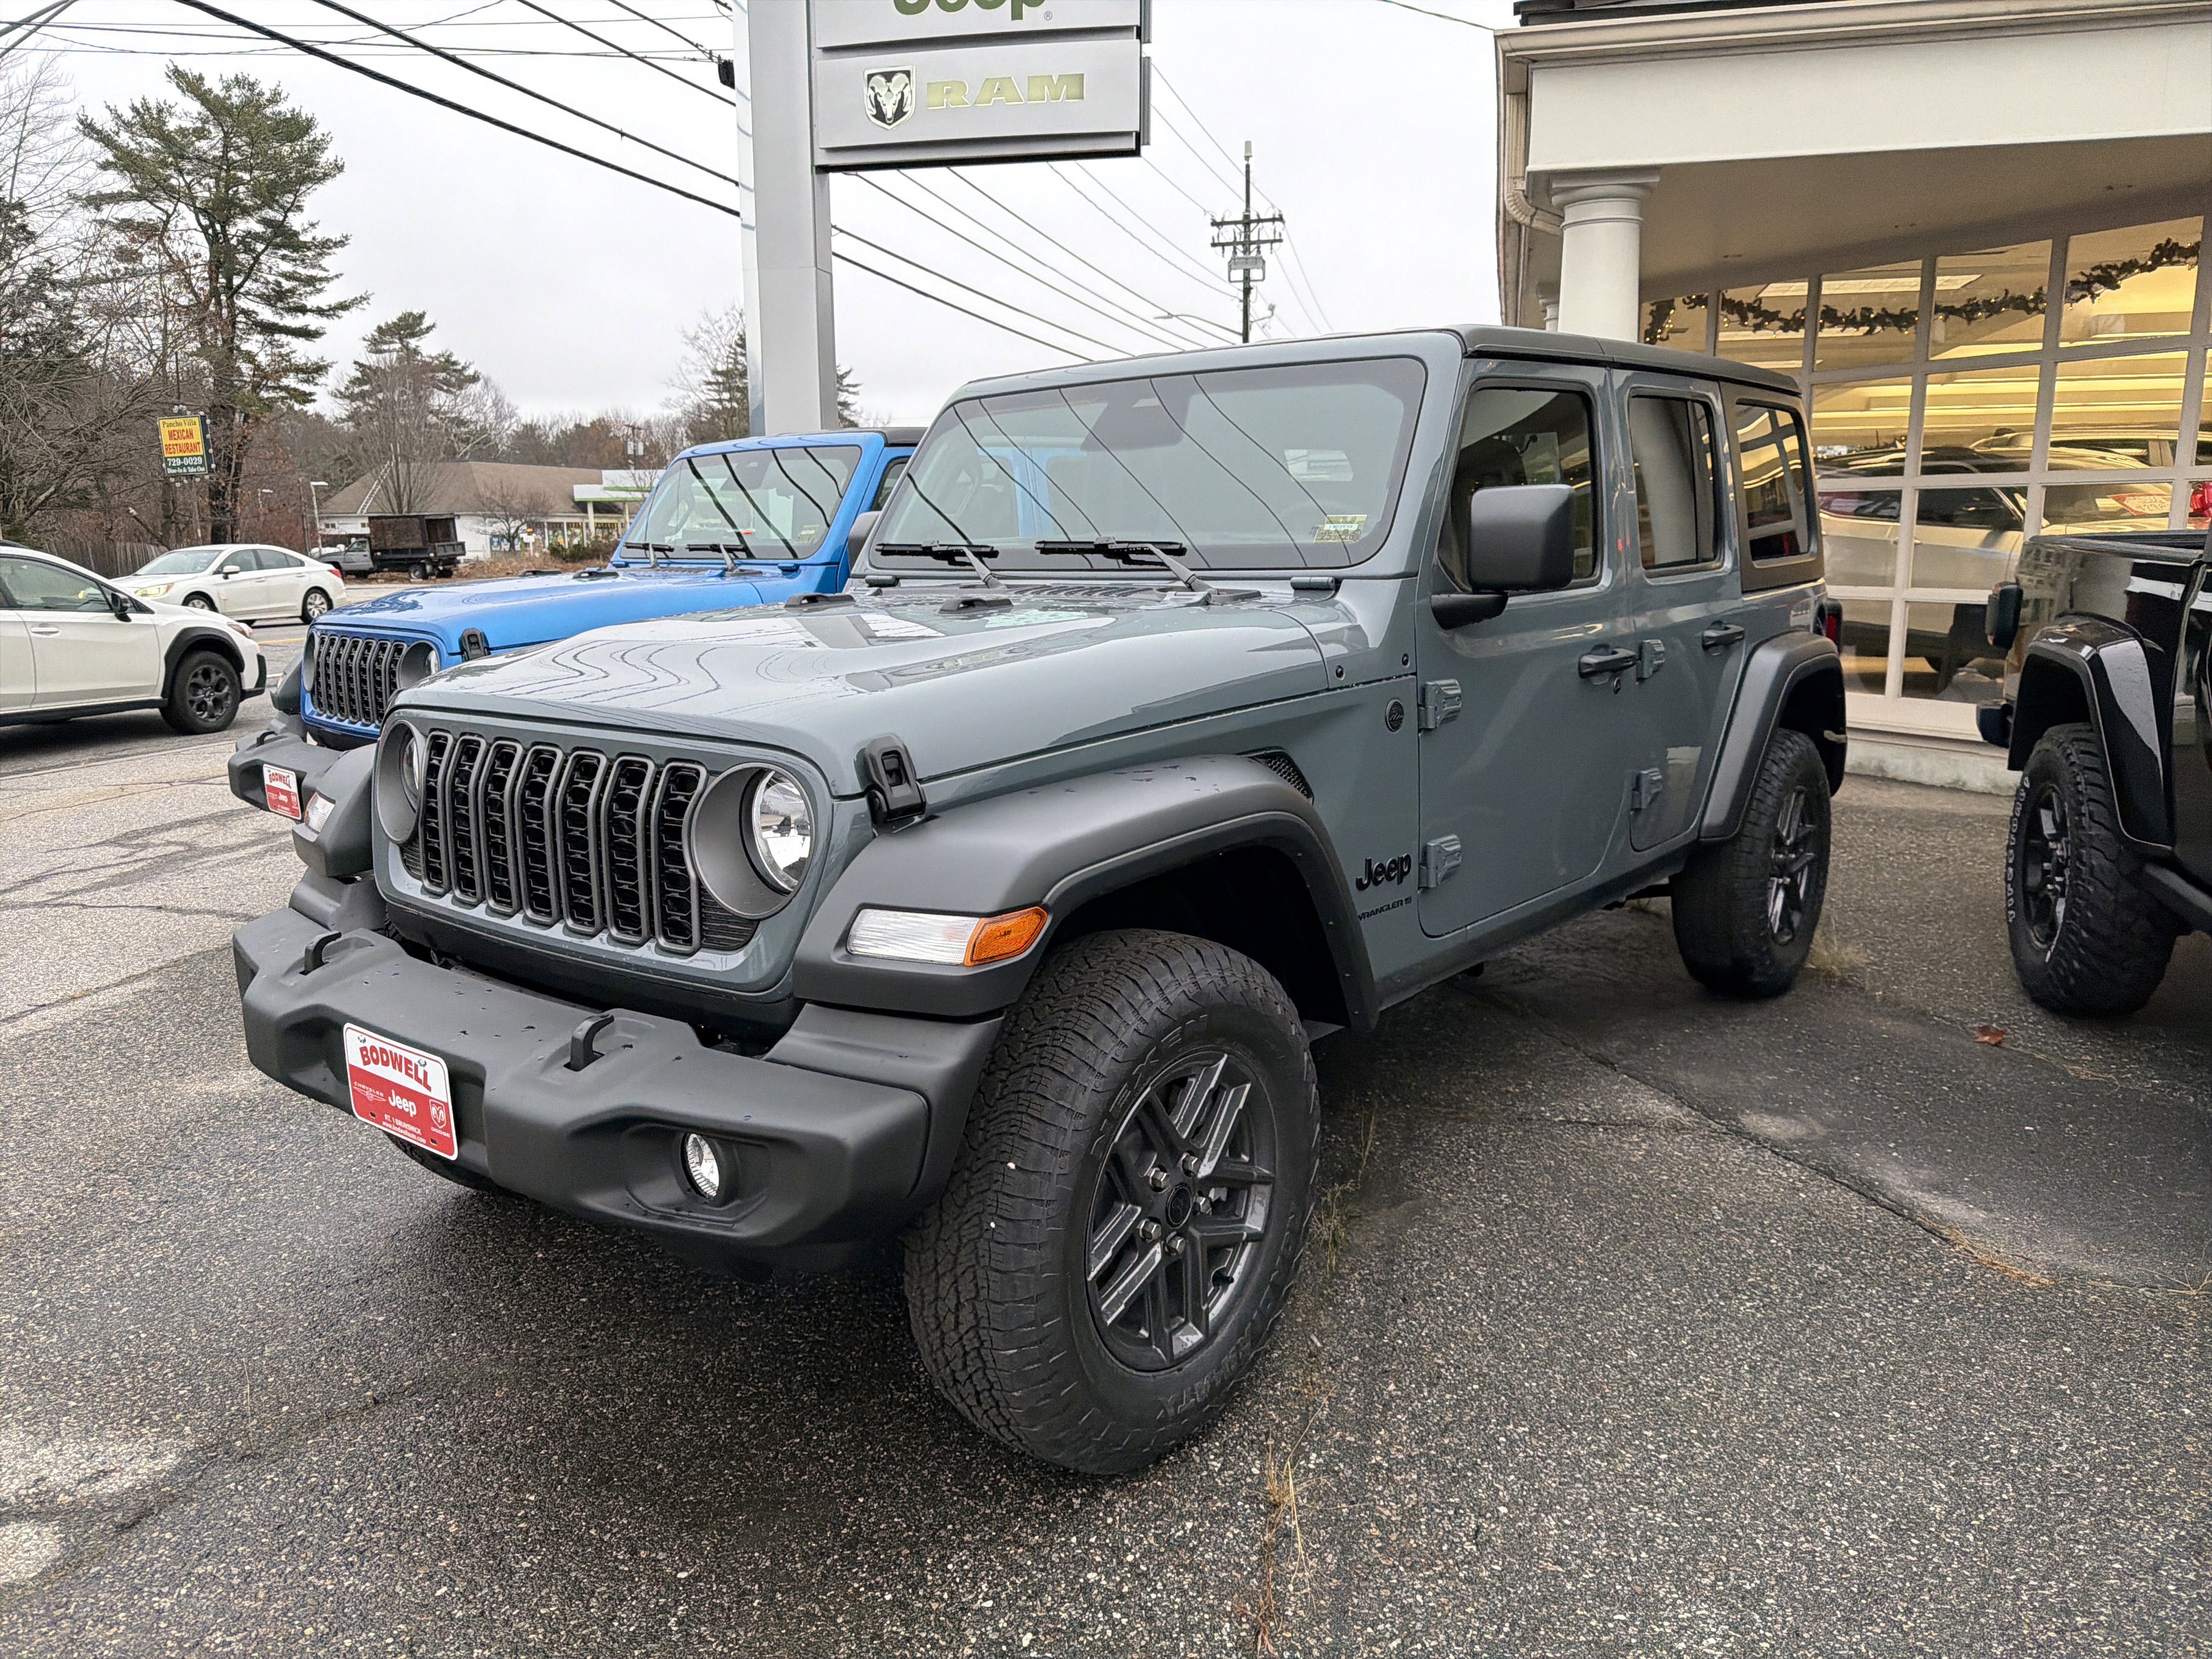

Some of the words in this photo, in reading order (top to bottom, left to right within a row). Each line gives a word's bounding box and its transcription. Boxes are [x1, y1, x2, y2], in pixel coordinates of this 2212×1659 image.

[926, 73, 1085, 110] RAM
[168, 428, 194, 441] MEXICAN
[165, 442, 201, 455] RESTAURANT
[167, 456, 202, 466] 729-0029
[1356, 853, 1412, 891] Jeep
[359, 1045, 432, 1092] BODWELL
[354, 1081, 384, 1097] CHRYSLER
[388, 1089, 417, 1118] Jeep
[431, 1126, 450, 1138] DODGE
